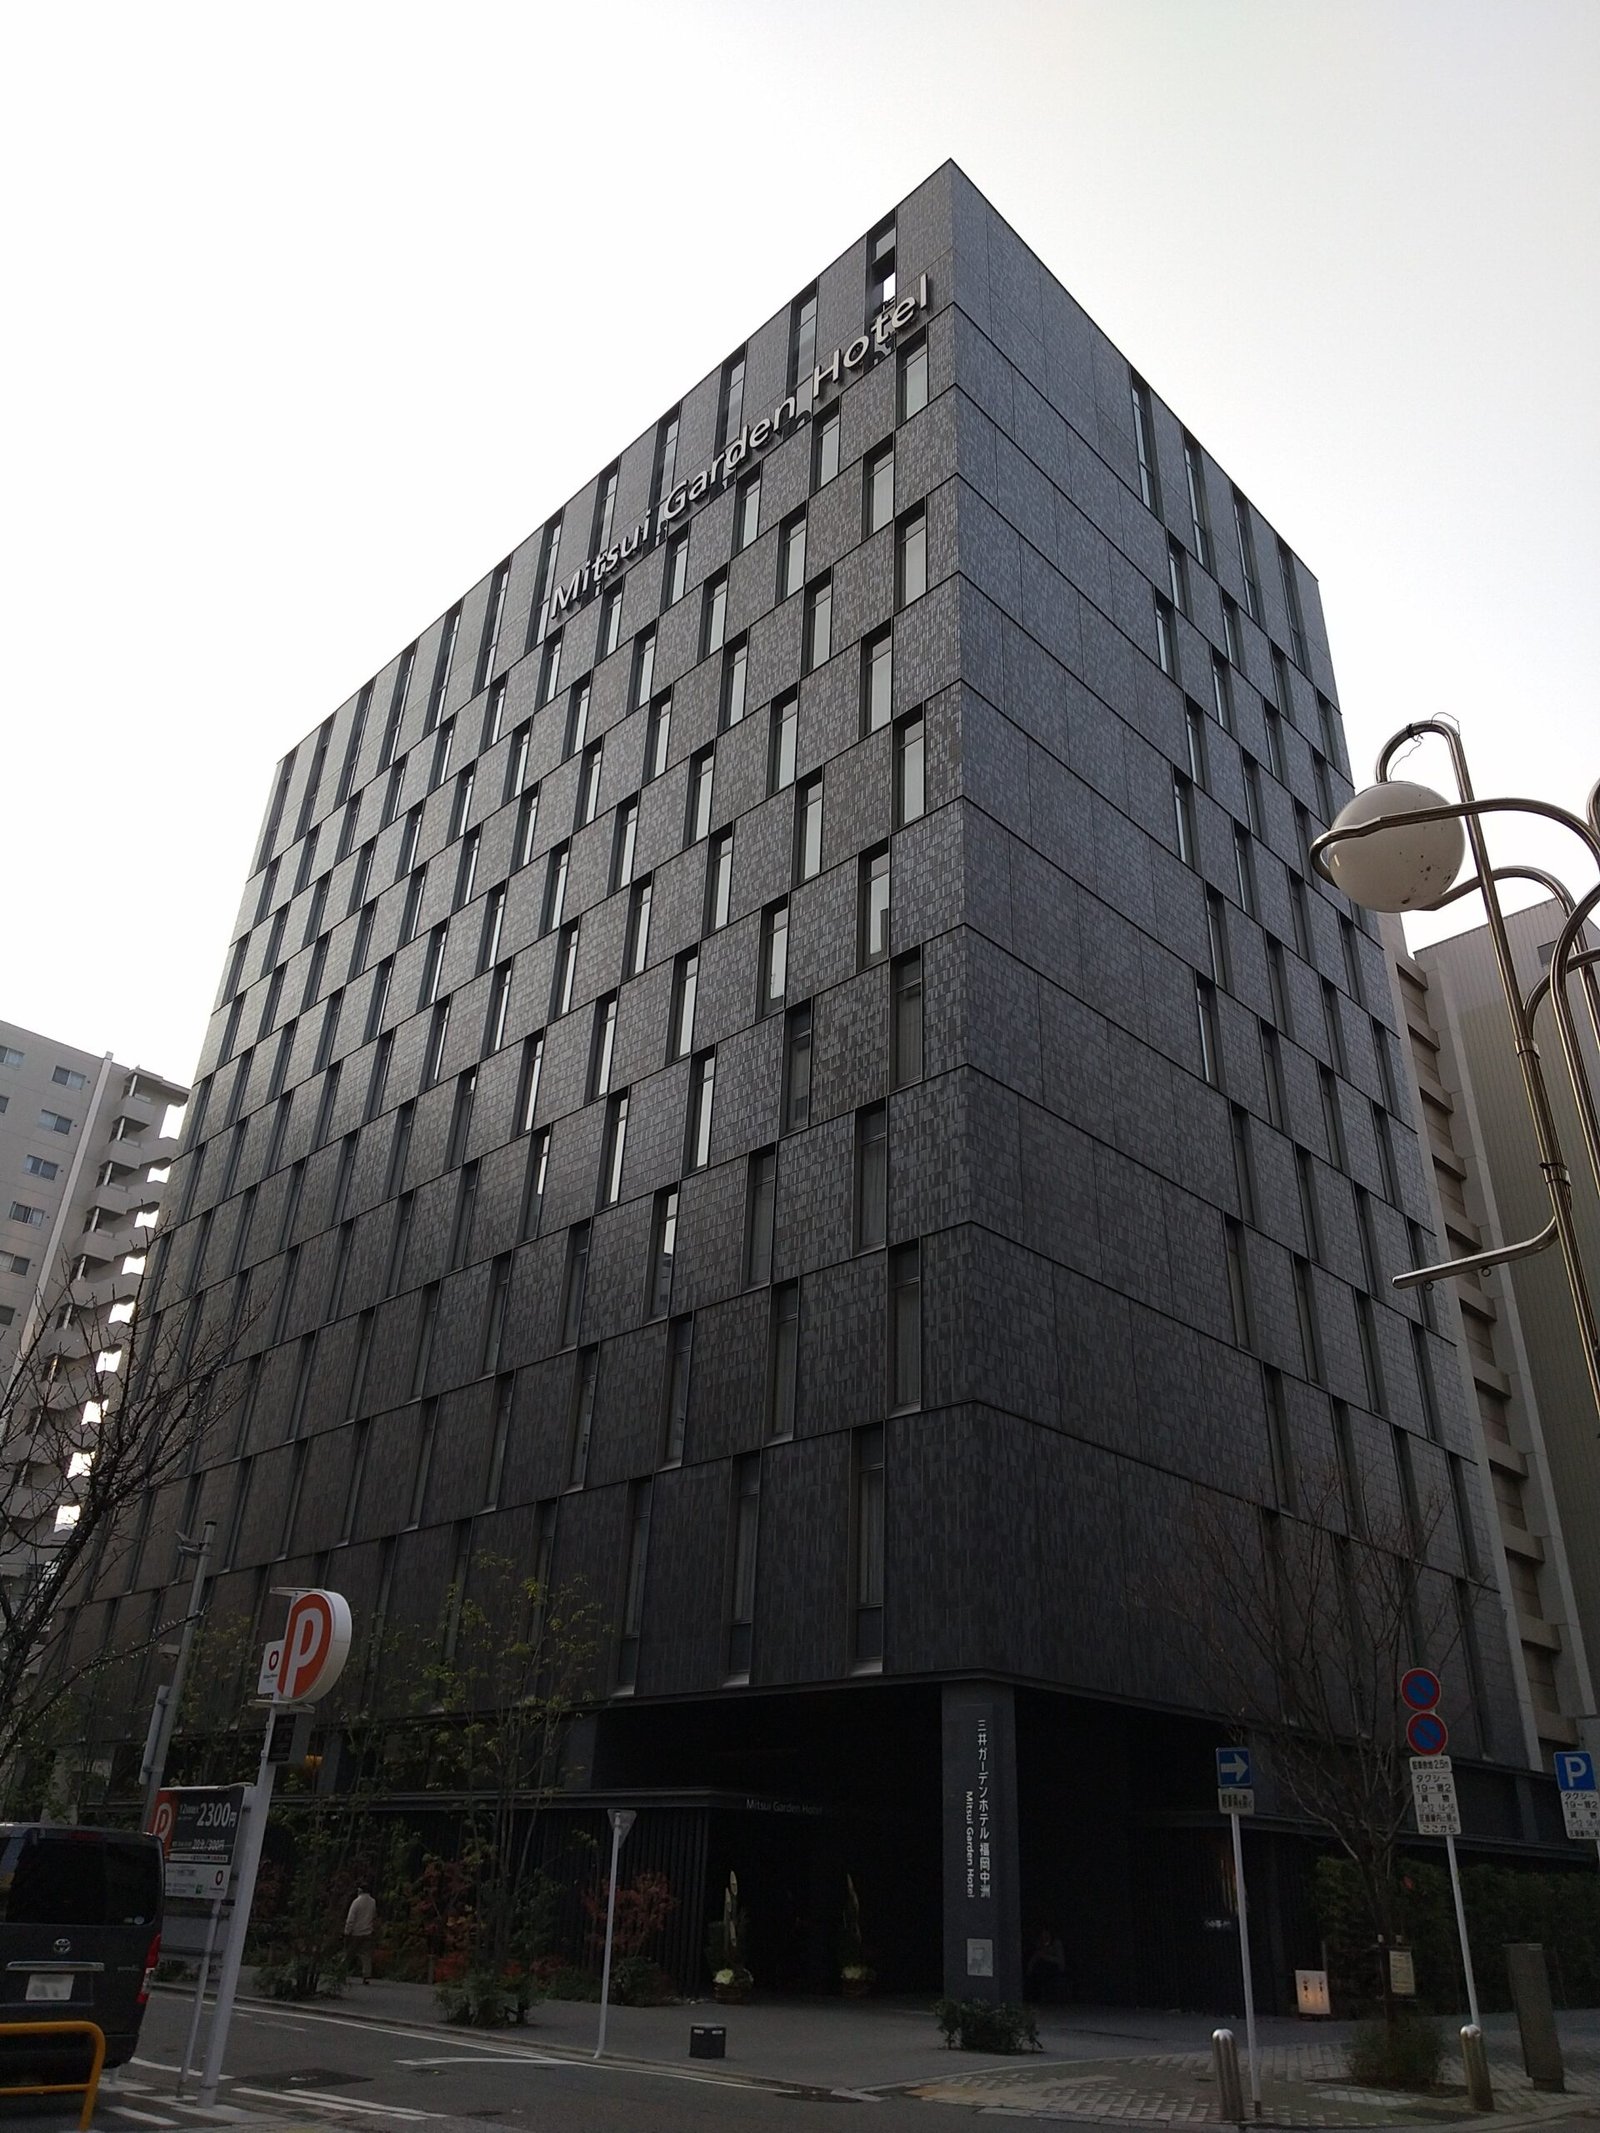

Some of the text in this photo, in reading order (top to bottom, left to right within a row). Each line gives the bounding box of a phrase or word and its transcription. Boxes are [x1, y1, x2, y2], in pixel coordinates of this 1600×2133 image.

[551, 273, 929, 619] Mitsui Garden Hotel
[283, 1607, 324, 1698] P
[977, 1719, 990, 1840] 三井ガーデンホテル
[1416, 1774, 1449, 1783] タクシー
[1564, 1756, 1588, 1788] P
[746, 1798, 771, 1811] Mitsui
[773, 1801, 800, 1813] Garden
[1423, 1824, 1457, 1834] ここから
[966, 1791, 975, 1898] Mitsui Garden Hotel
